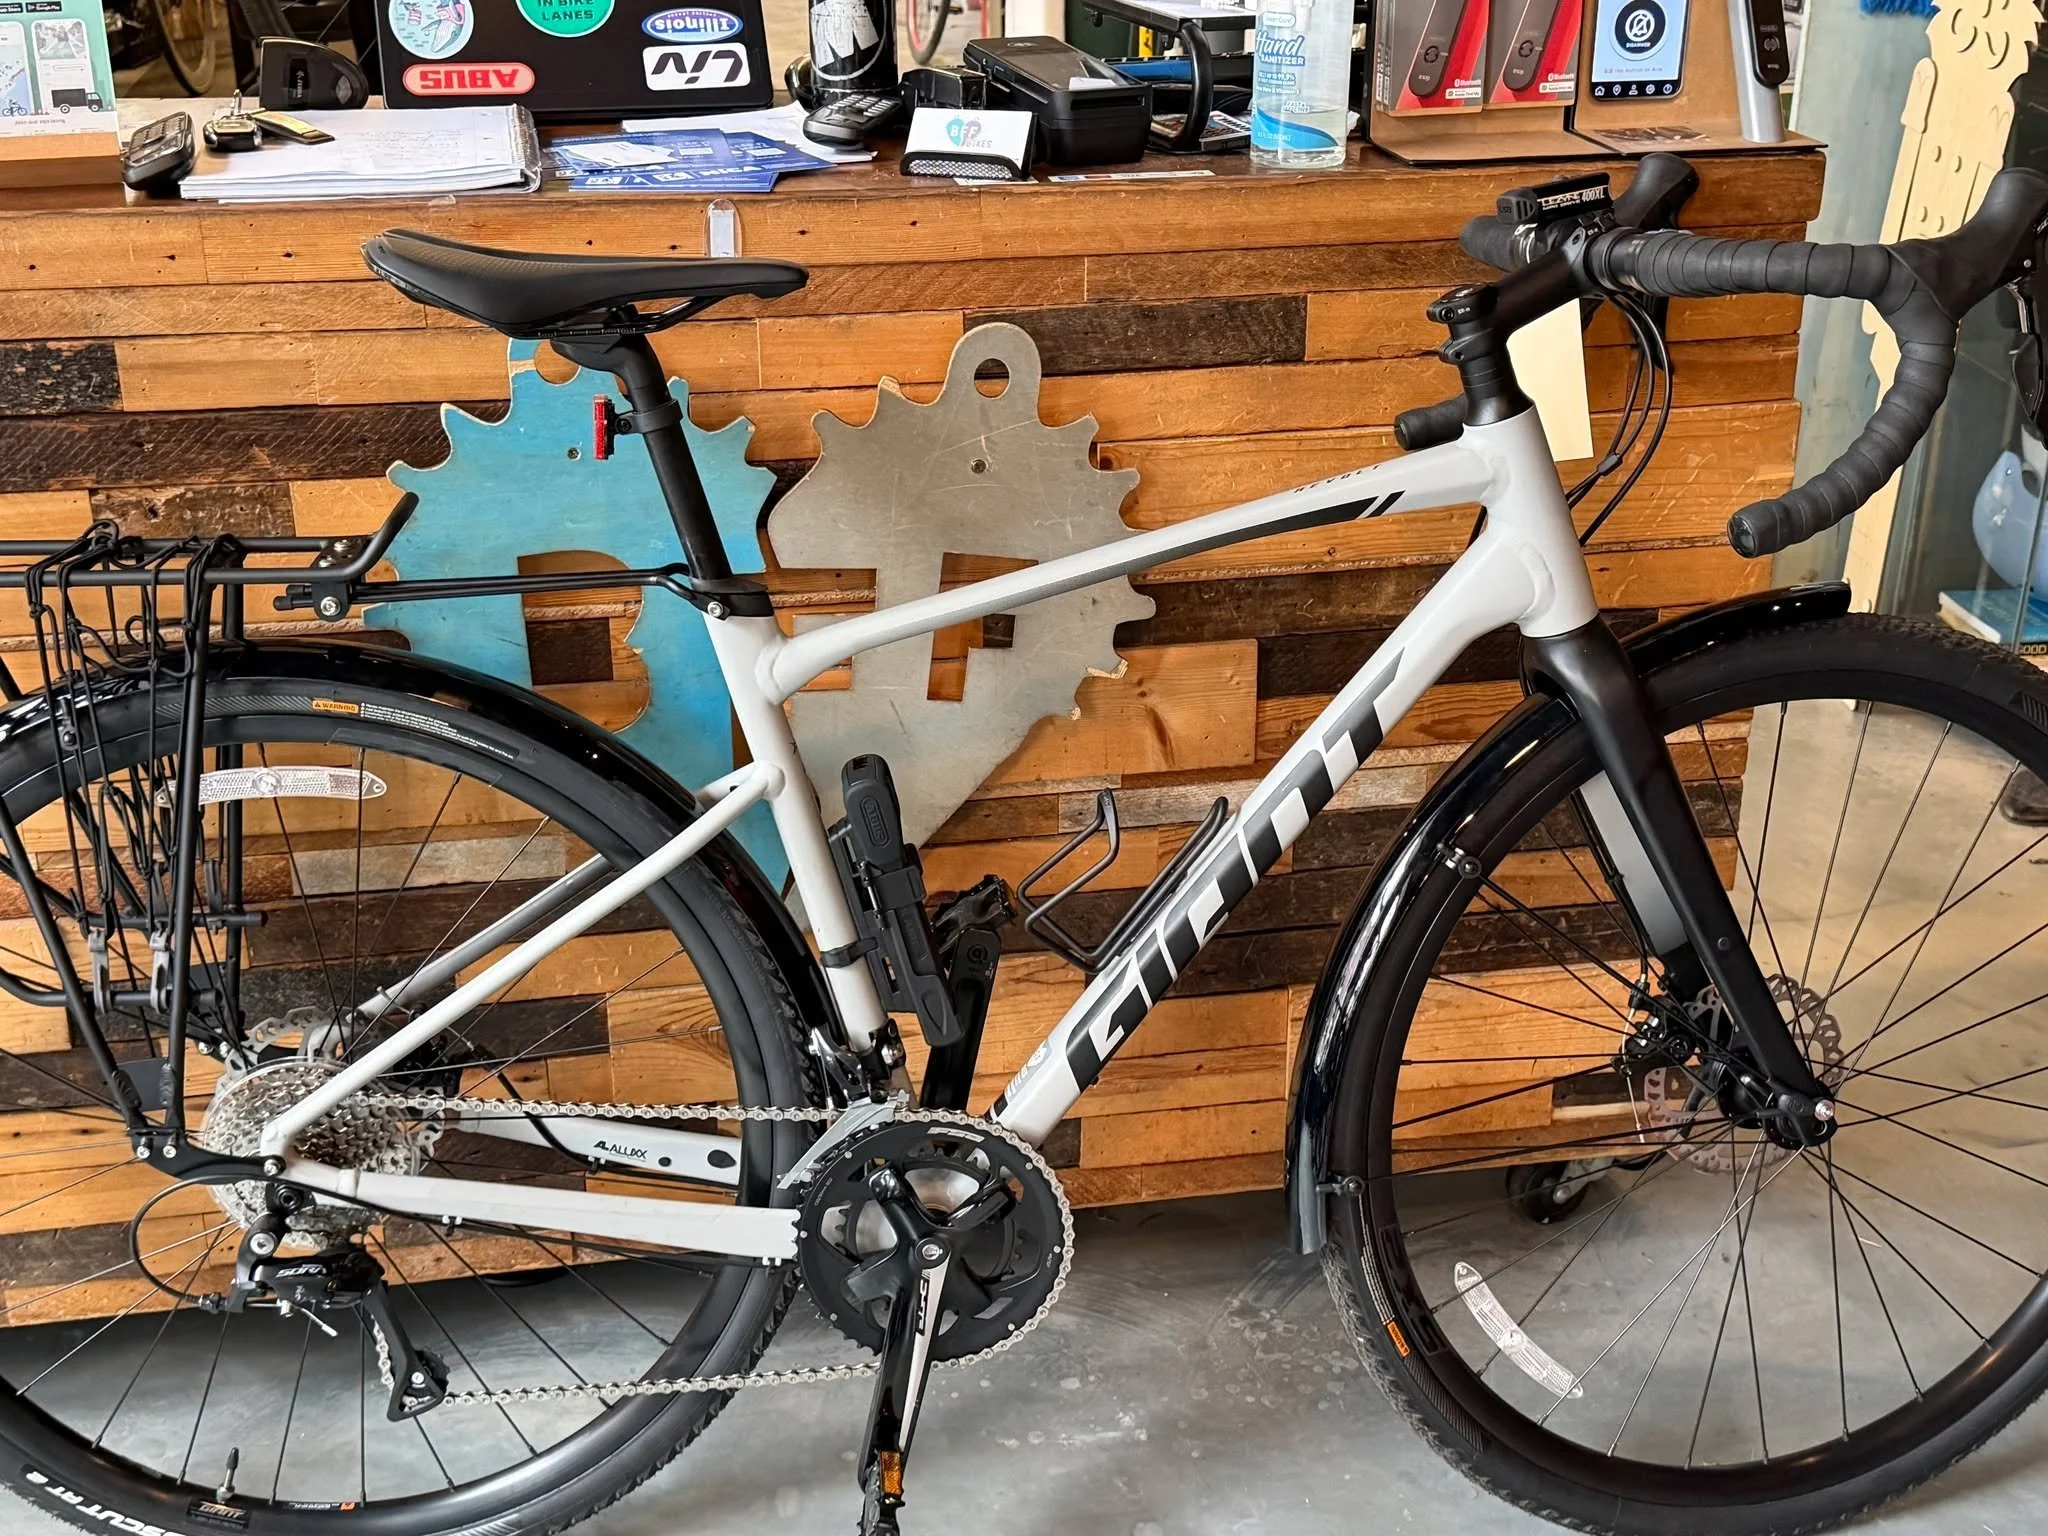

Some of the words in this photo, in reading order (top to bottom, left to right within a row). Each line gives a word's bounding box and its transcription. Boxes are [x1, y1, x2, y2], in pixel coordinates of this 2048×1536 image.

[541, 10, 594, 21] LANES
[655, 17, 730, 33] Illinois
[1255, 31, 1305, 57] Hand
[650, 49, 744, 85] Liv
[1260, 56, 1305, 66] SANITIZER
[419, 69, 519, 90] ABUS
[965, 140, 993, 149] BIKES
[1541, 191, 1581, 206] LEZYNE
[1582, 186, 1605, 203] 400XL
[322, 702, 357, 712] WARNING
[1066, 646, 1406, 1094] GIANT
